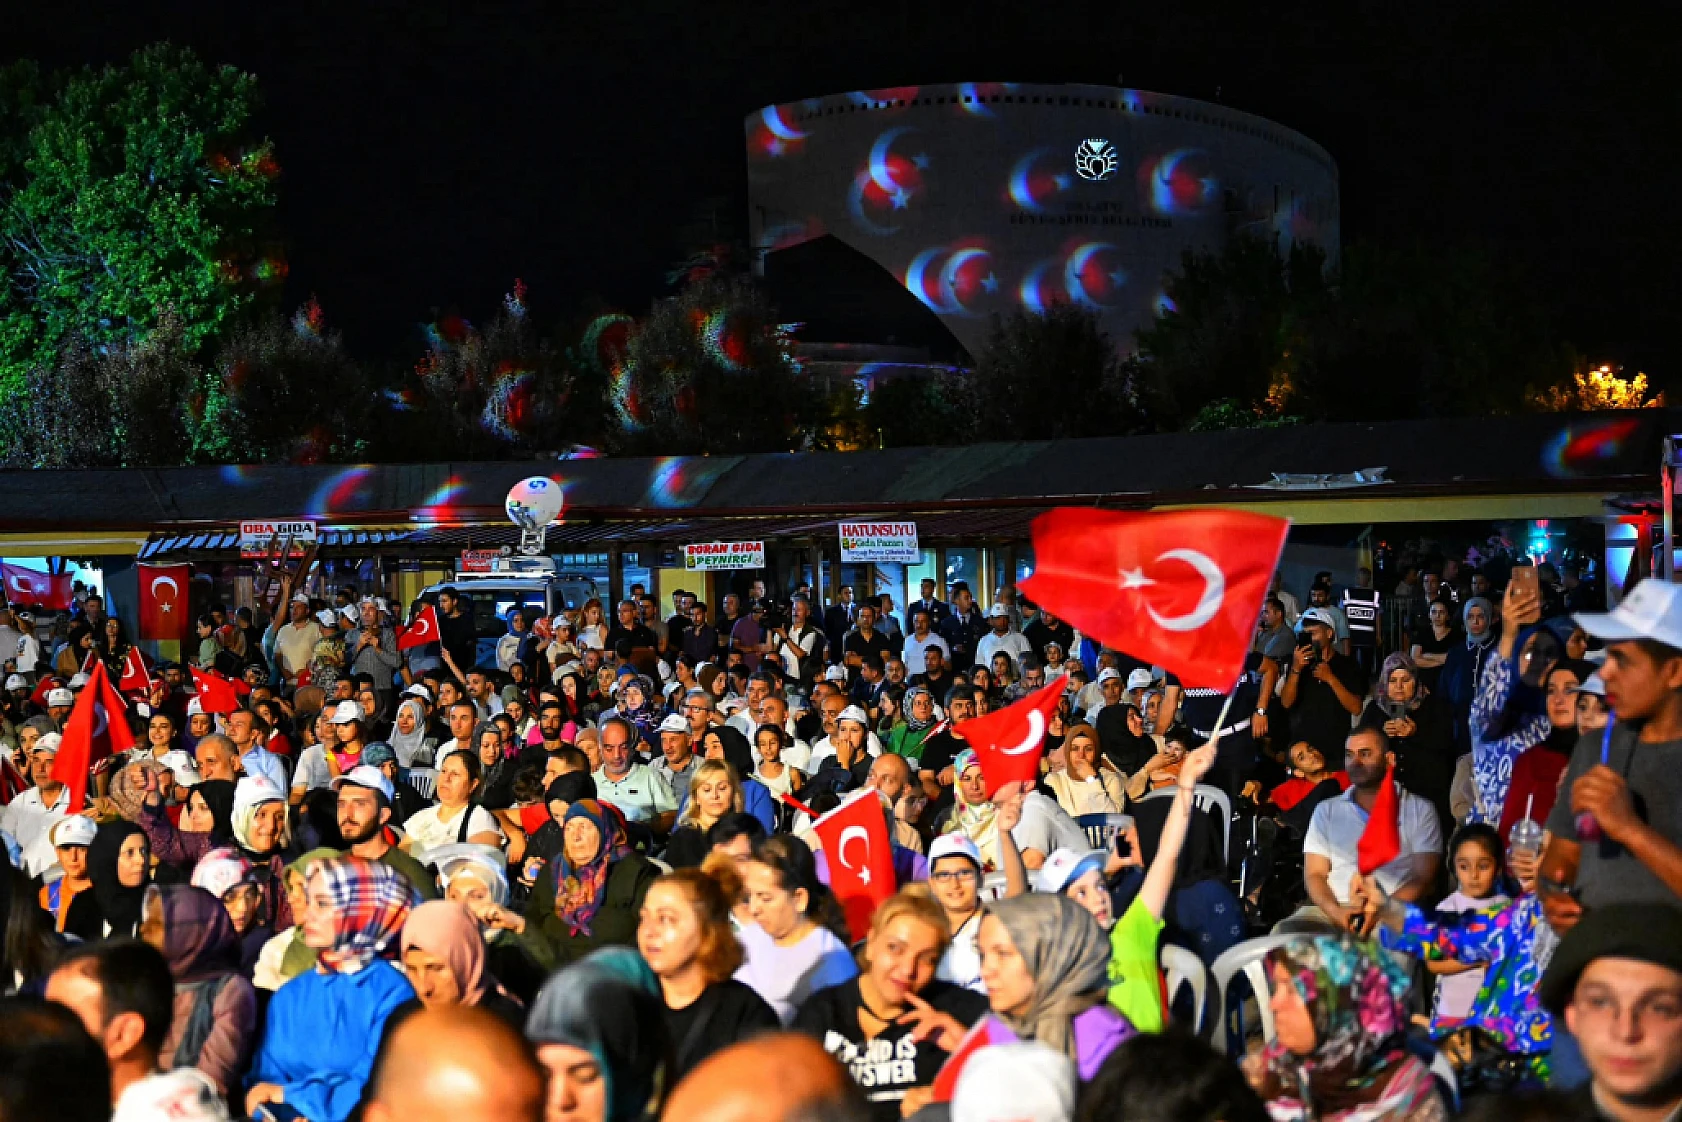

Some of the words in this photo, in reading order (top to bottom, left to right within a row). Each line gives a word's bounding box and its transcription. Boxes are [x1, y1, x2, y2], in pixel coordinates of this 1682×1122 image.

[244, 524, 274, 533] OBA
[842, 524, 914, 537] HATUNSUYU
[732, 543, 761, 552] GIDA
